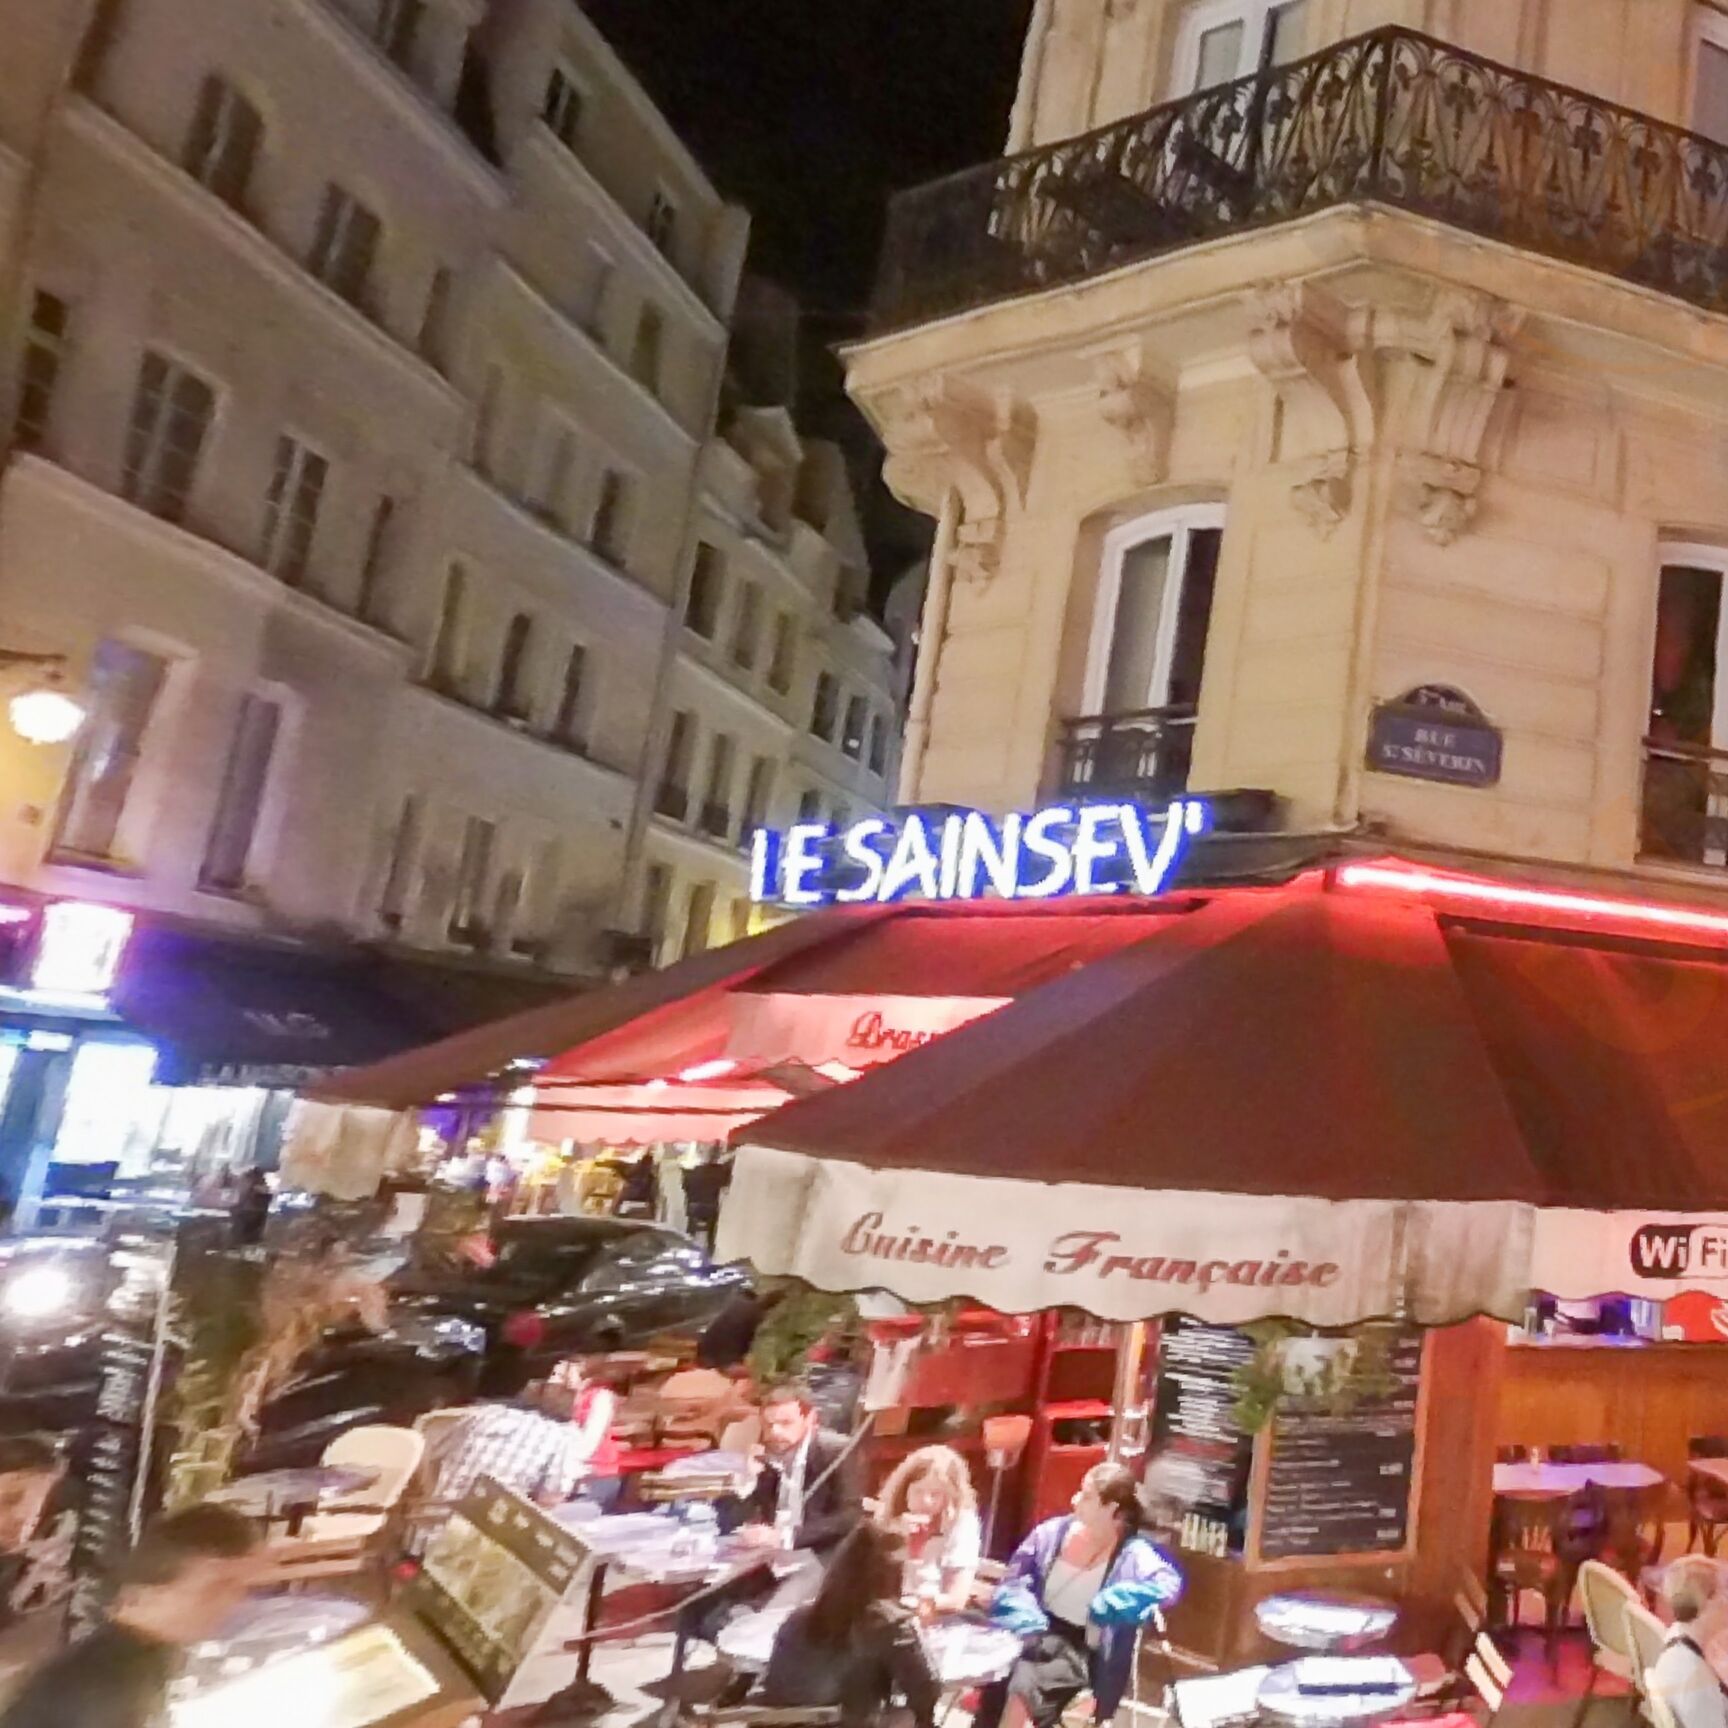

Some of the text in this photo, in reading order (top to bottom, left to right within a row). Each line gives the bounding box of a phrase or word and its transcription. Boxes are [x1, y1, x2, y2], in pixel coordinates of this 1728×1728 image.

[1415, 728, 1456, 749] RUE
[841, 1211, 1340, 1294] Cuisine Française
